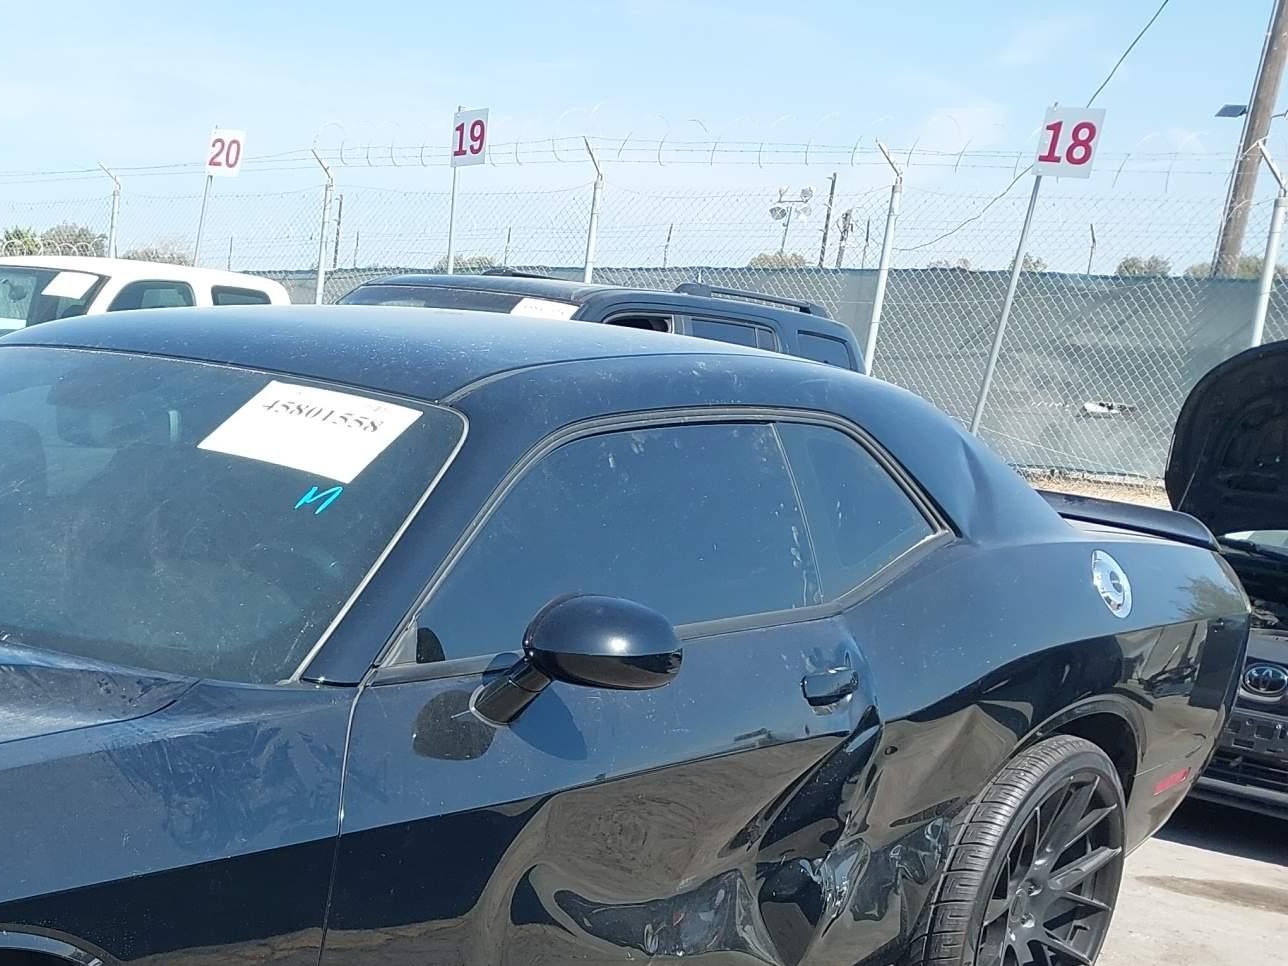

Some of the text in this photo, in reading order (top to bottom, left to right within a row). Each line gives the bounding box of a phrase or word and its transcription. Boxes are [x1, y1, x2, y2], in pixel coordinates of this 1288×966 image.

[208, 137, 241, 168] 20
[453, 119, 485, 156] 19
[1038, 120, 1097, 166] 18
[262, 399, 385, 433] 45801558
